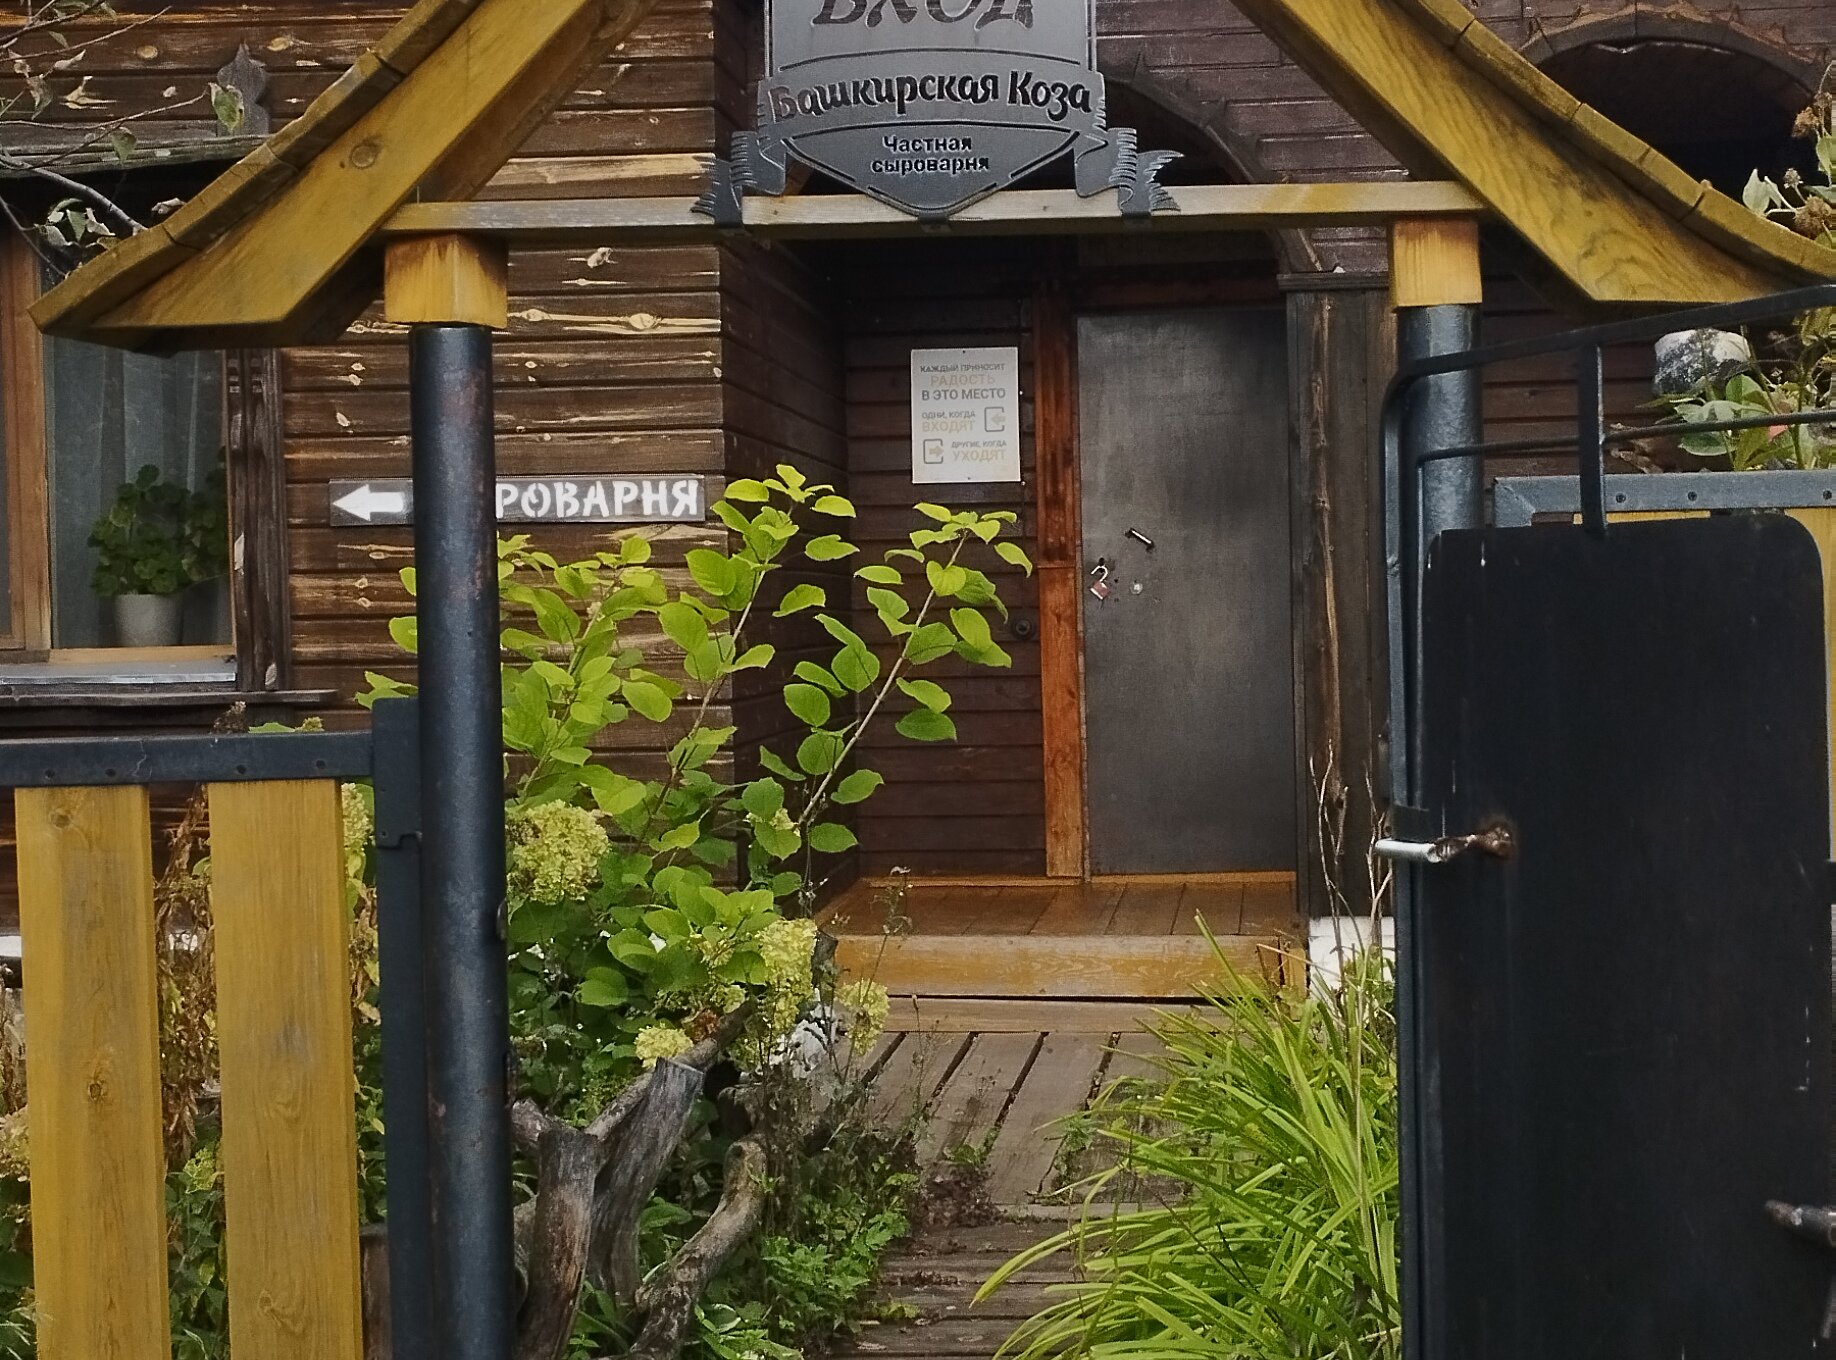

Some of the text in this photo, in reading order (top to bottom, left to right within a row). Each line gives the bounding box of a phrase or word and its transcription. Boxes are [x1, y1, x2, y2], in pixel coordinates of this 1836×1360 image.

[768, 70, 1093, 121] Башкирская Коза
[883, 135, 972, 153] Частная
[871, 156, 990, 175] сыроварня
[960, 363, 1005, 372] ПРИНОСИТ
[930, 374, 996, 386] РАДОСТЬ
[921, 388, 1006, 401] В ЭТО МЕСТО
[949, 410, 976, 419] КОГДА
[921, 420, 976, 433] ВХОДЯТ
[983, 439, 1007, 447] КОГДА
[952, 449, 1007, 462] УХОДЯТ
[496, 479, 700, 519] РОВАРНЯ
